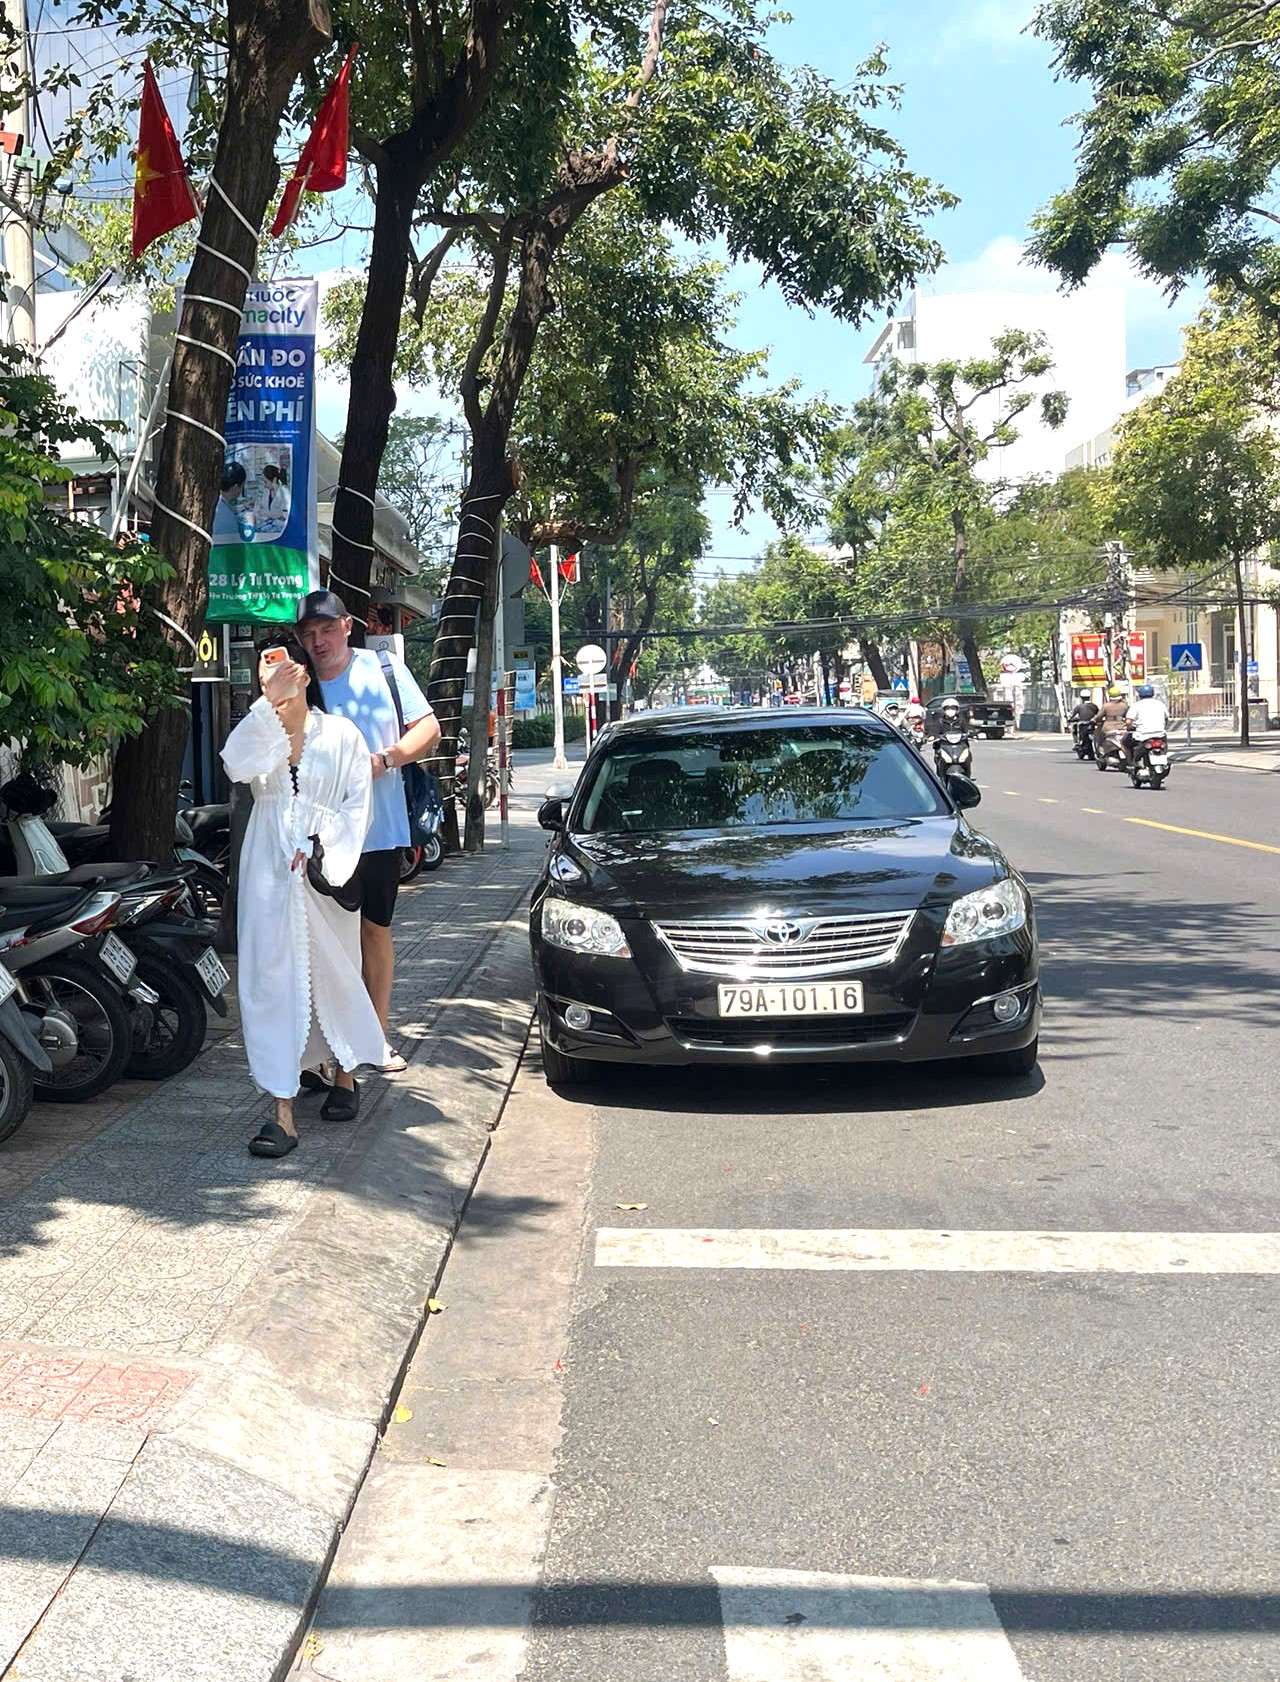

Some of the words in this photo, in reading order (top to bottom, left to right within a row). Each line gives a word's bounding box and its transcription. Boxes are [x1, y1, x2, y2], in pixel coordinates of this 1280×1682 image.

[235, 342, 266, 367] ẤN
[271, 348, 306, 368] ĐO
[238, 374, 262, 388] SỨC
[259, 397, 303, 422] PHÍ
[231, 573, 246, 590] Lý
[264, 572, 303, 589] Trọng
[196, 629, 218, 669] ỘI
[723, 986, 858, 1014] 79A-101.16
